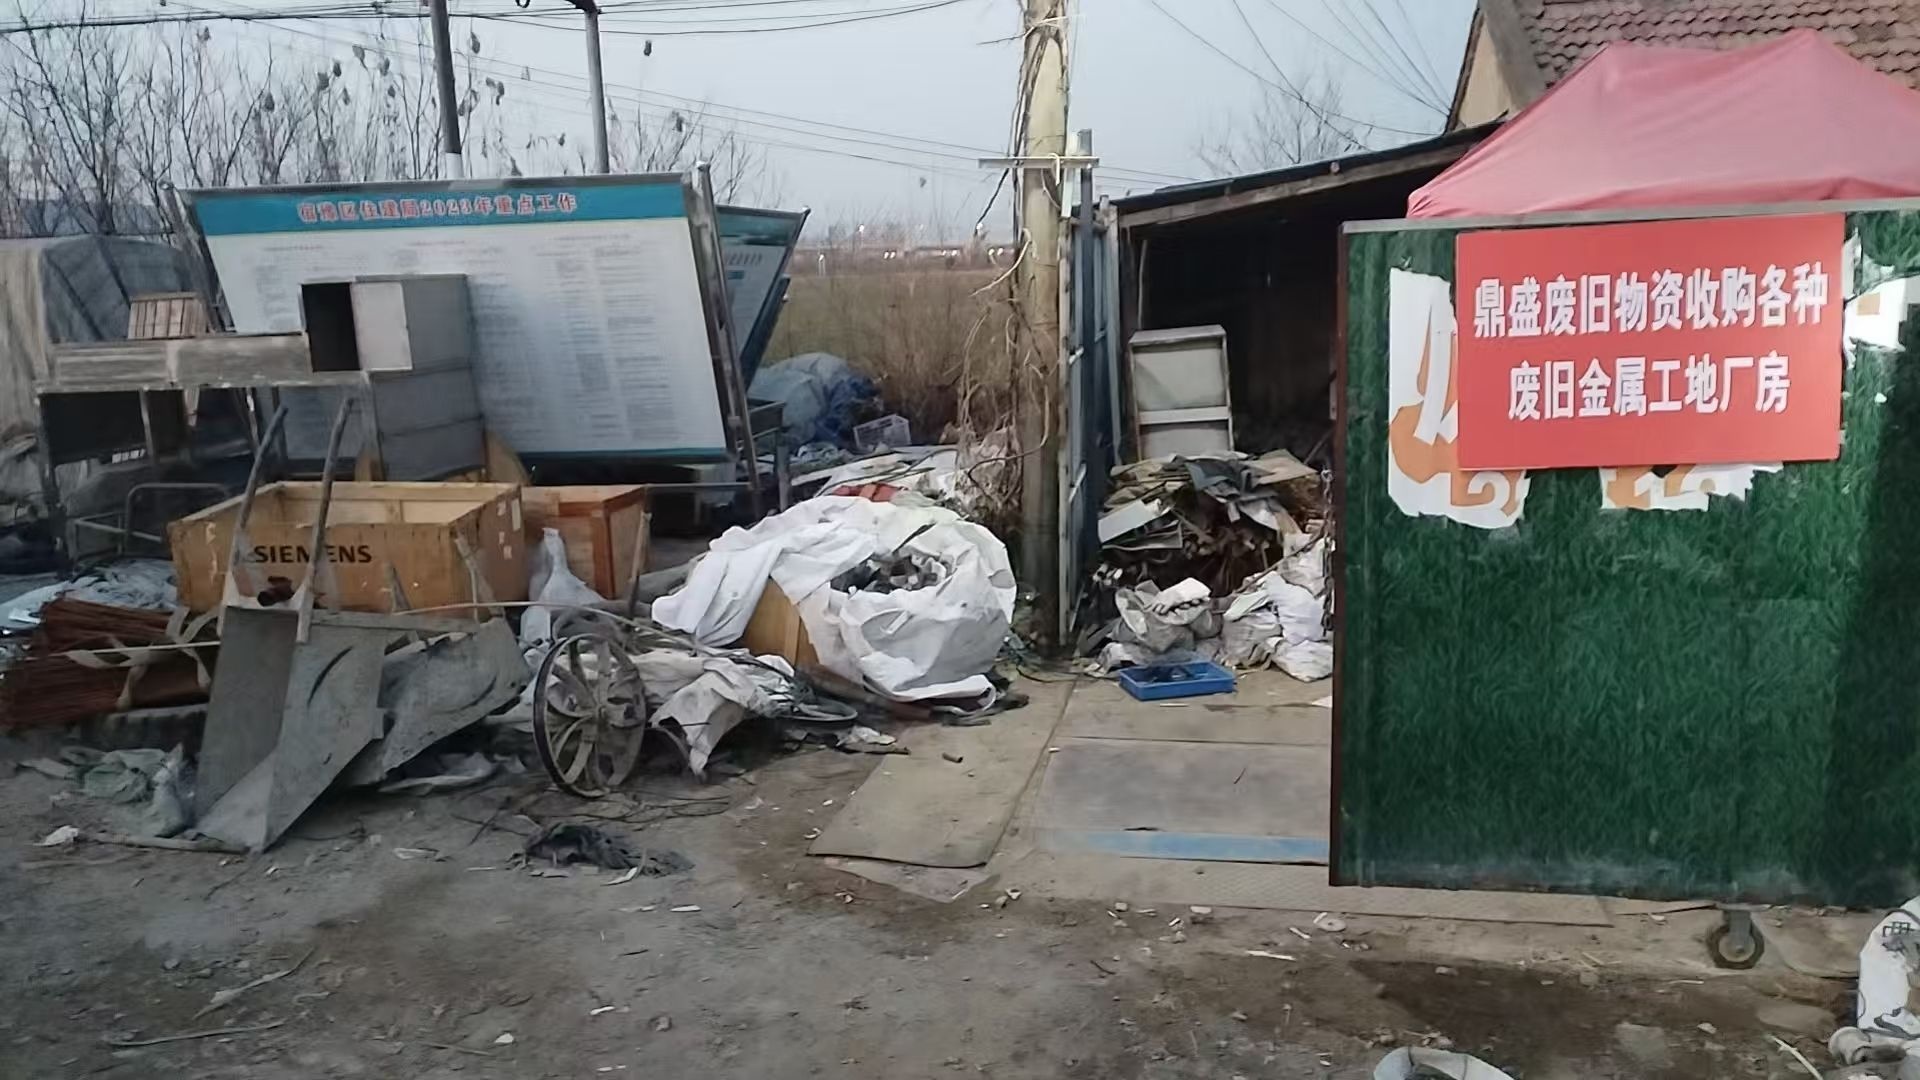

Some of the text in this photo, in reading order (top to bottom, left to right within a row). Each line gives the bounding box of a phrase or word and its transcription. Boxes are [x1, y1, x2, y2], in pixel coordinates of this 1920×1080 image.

[1474, 261, 1829, 338] 鼎盛废旧物资收购各种
[1508, 350, 1791, 421] 废旧金属工地厂房
